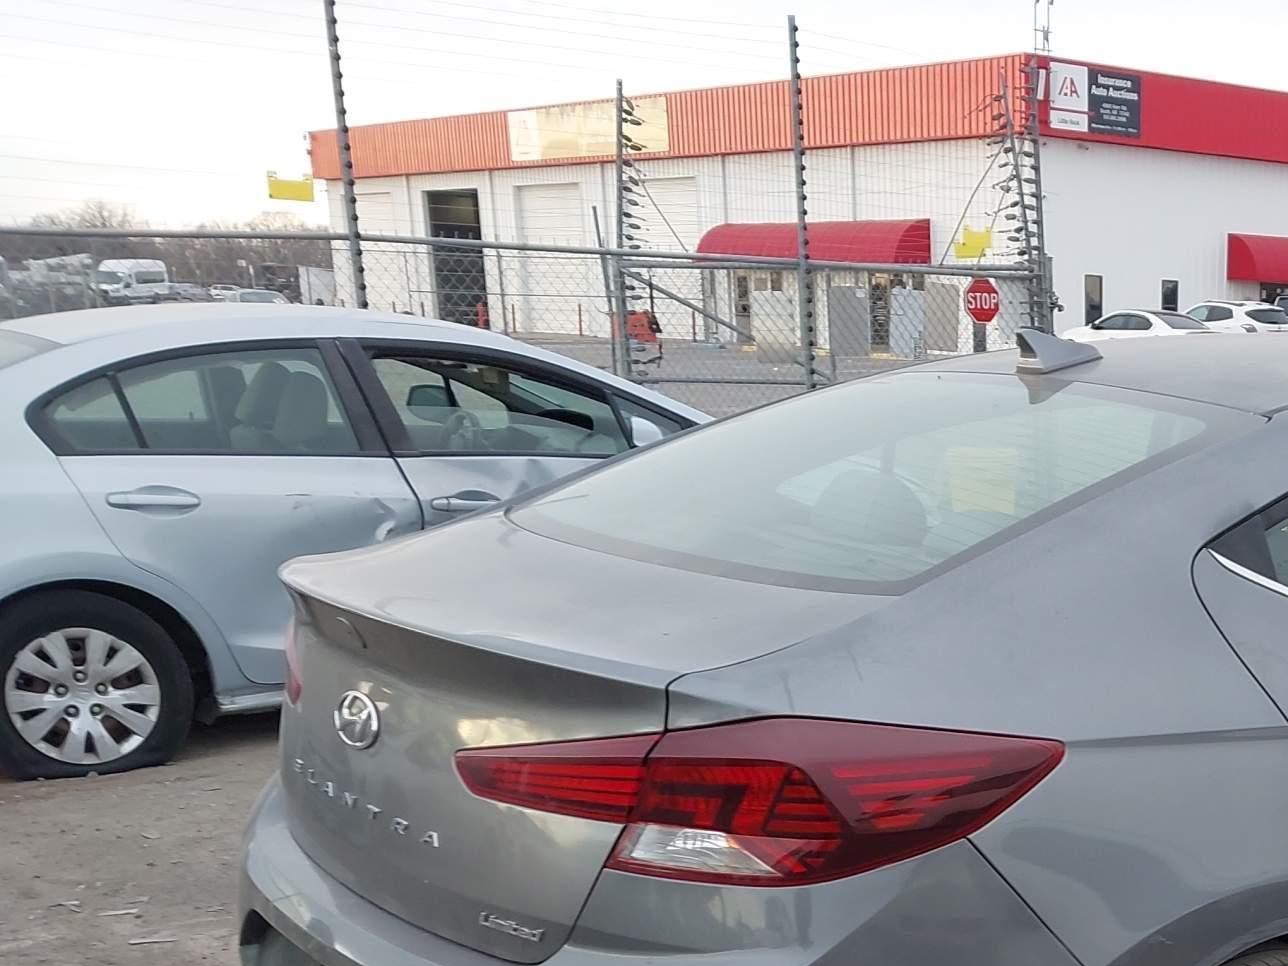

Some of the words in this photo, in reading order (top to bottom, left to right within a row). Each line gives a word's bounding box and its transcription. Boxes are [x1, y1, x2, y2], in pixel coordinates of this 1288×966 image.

[1090, 84, 1108, 96] Auto
[1108, 86, 1139, 100] Auctions
[967, 292, 998, 310] STOP
[294, 758, 440, 847] ELANTRA
[478, 911, 545, 942] Limited
